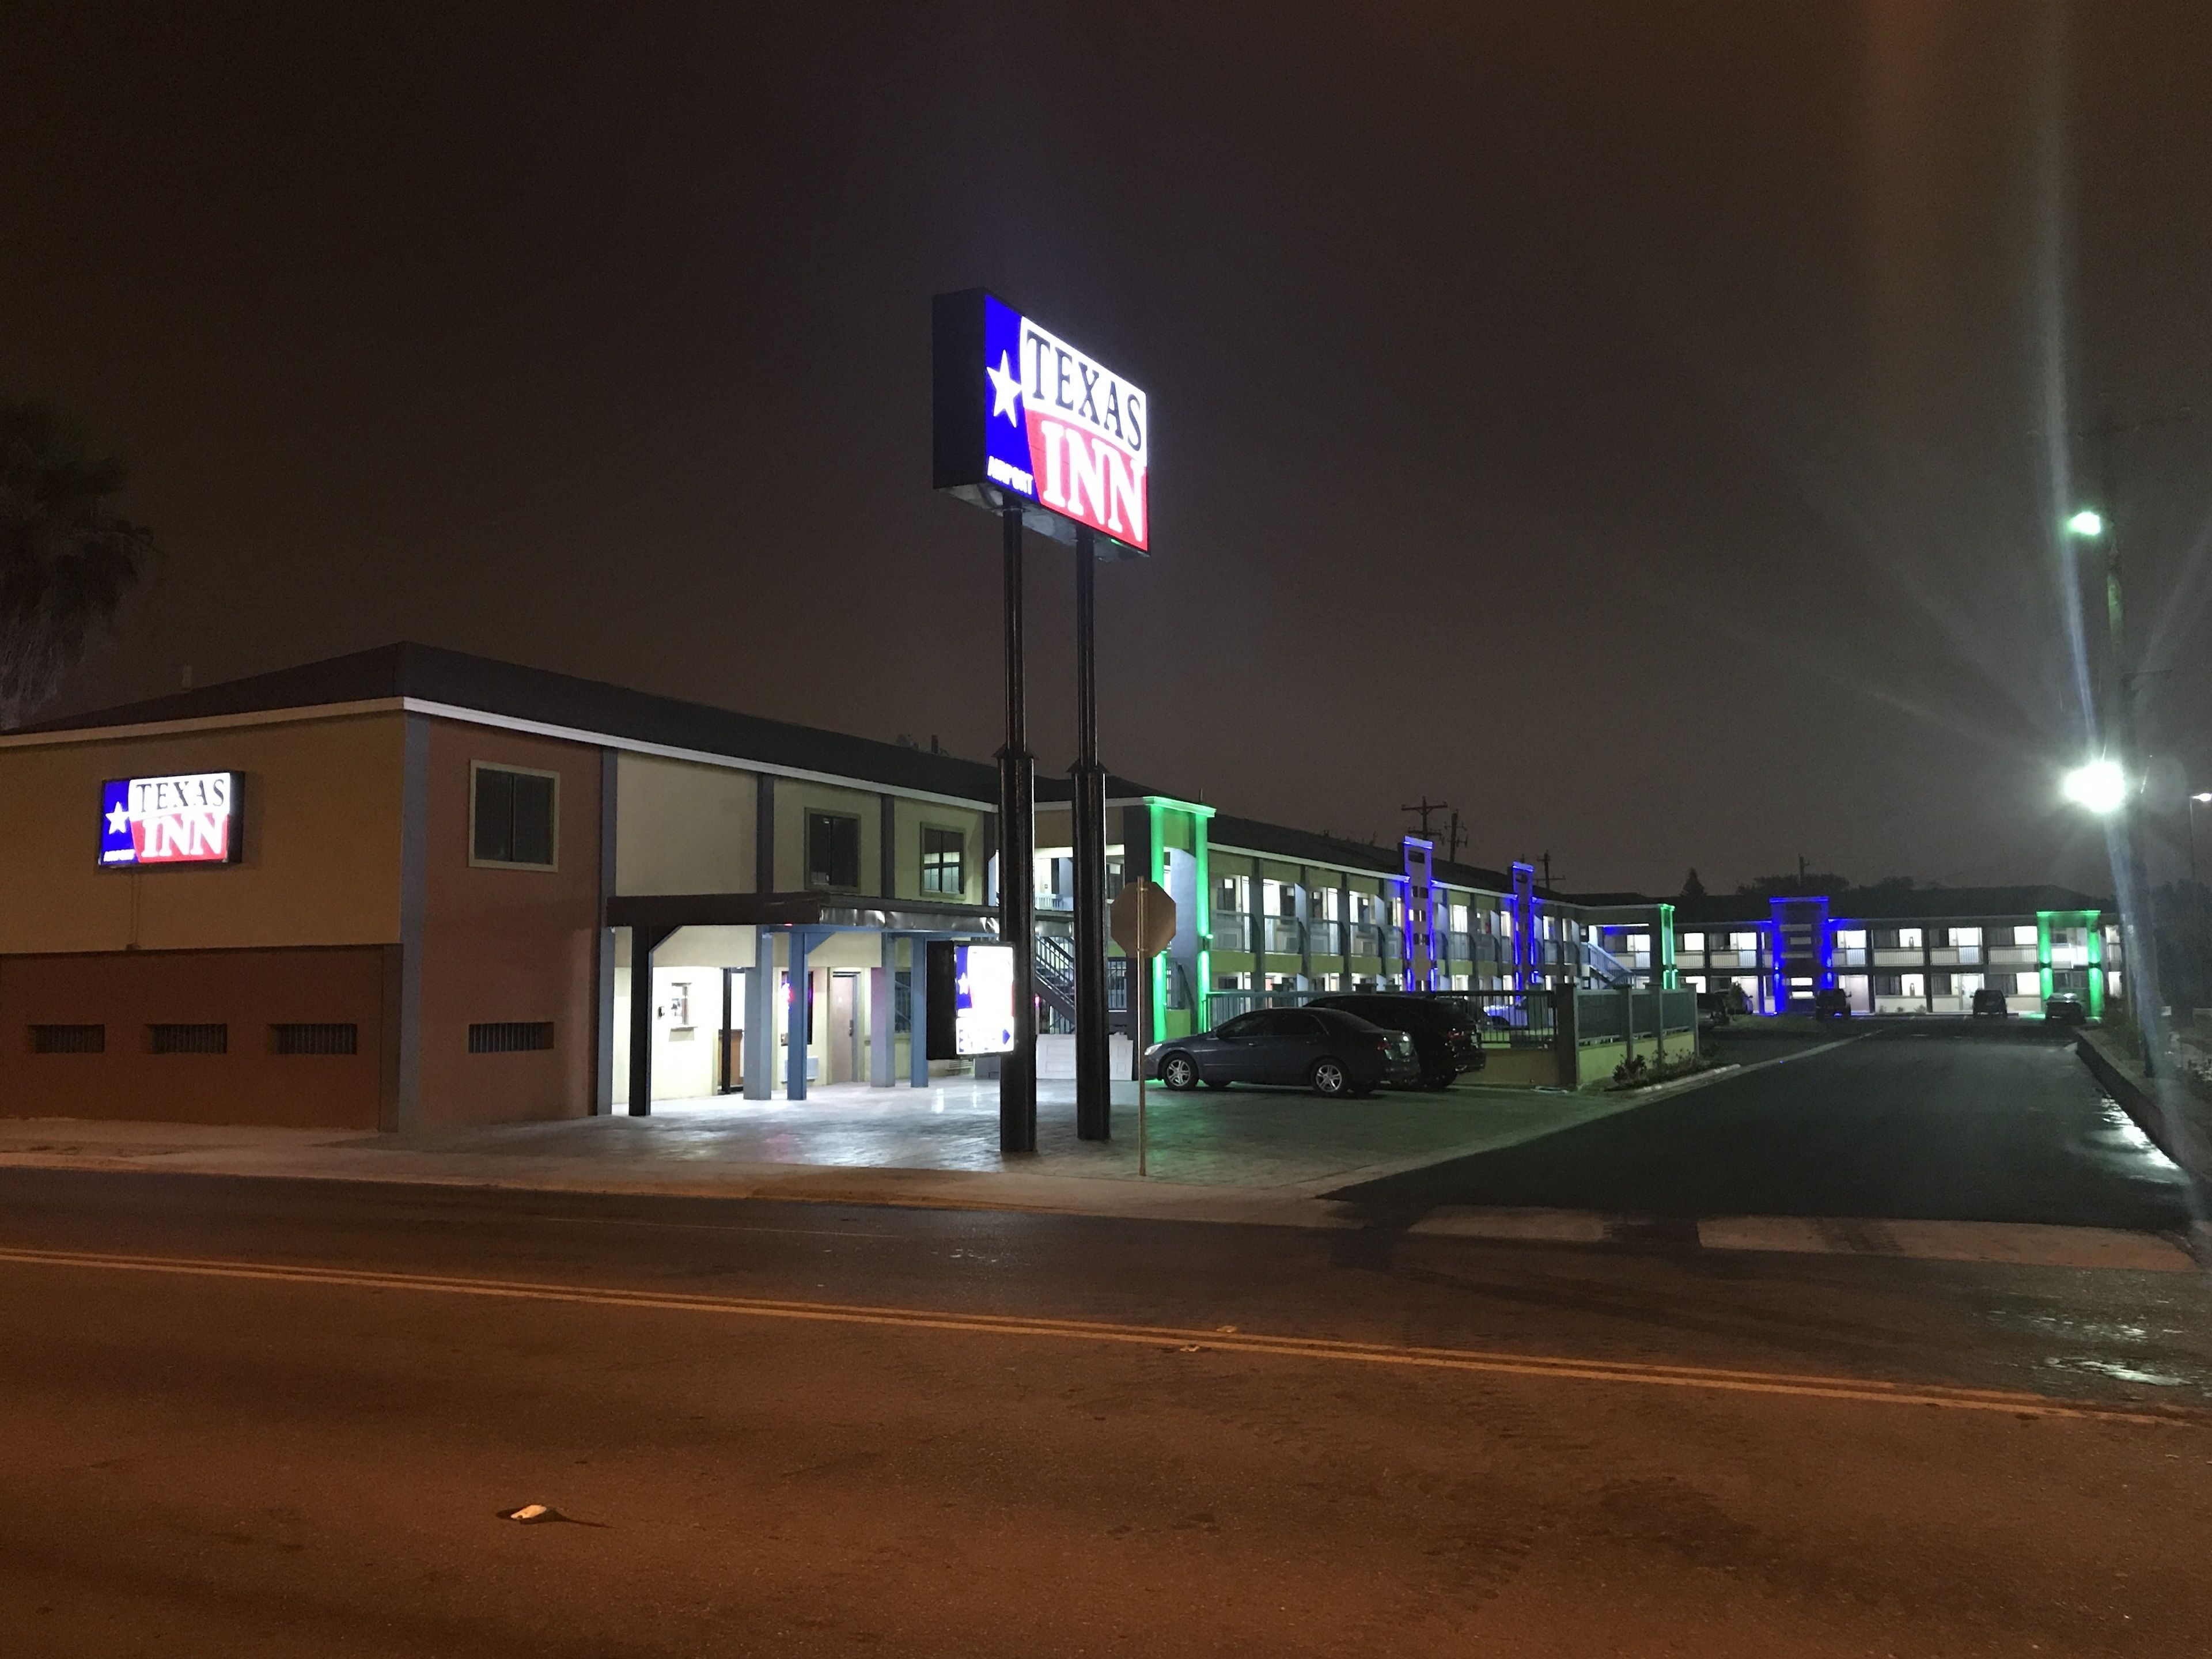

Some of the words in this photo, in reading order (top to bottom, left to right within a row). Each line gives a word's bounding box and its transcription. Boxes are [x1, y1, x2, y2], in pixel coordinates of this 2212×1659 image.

[1027, 329, 1142, 452] TEXAS
[1041, 419, 1145, 543] INN
[135, 779, 225, 813] TEXAS
[141, 812, 227, 858] INN
